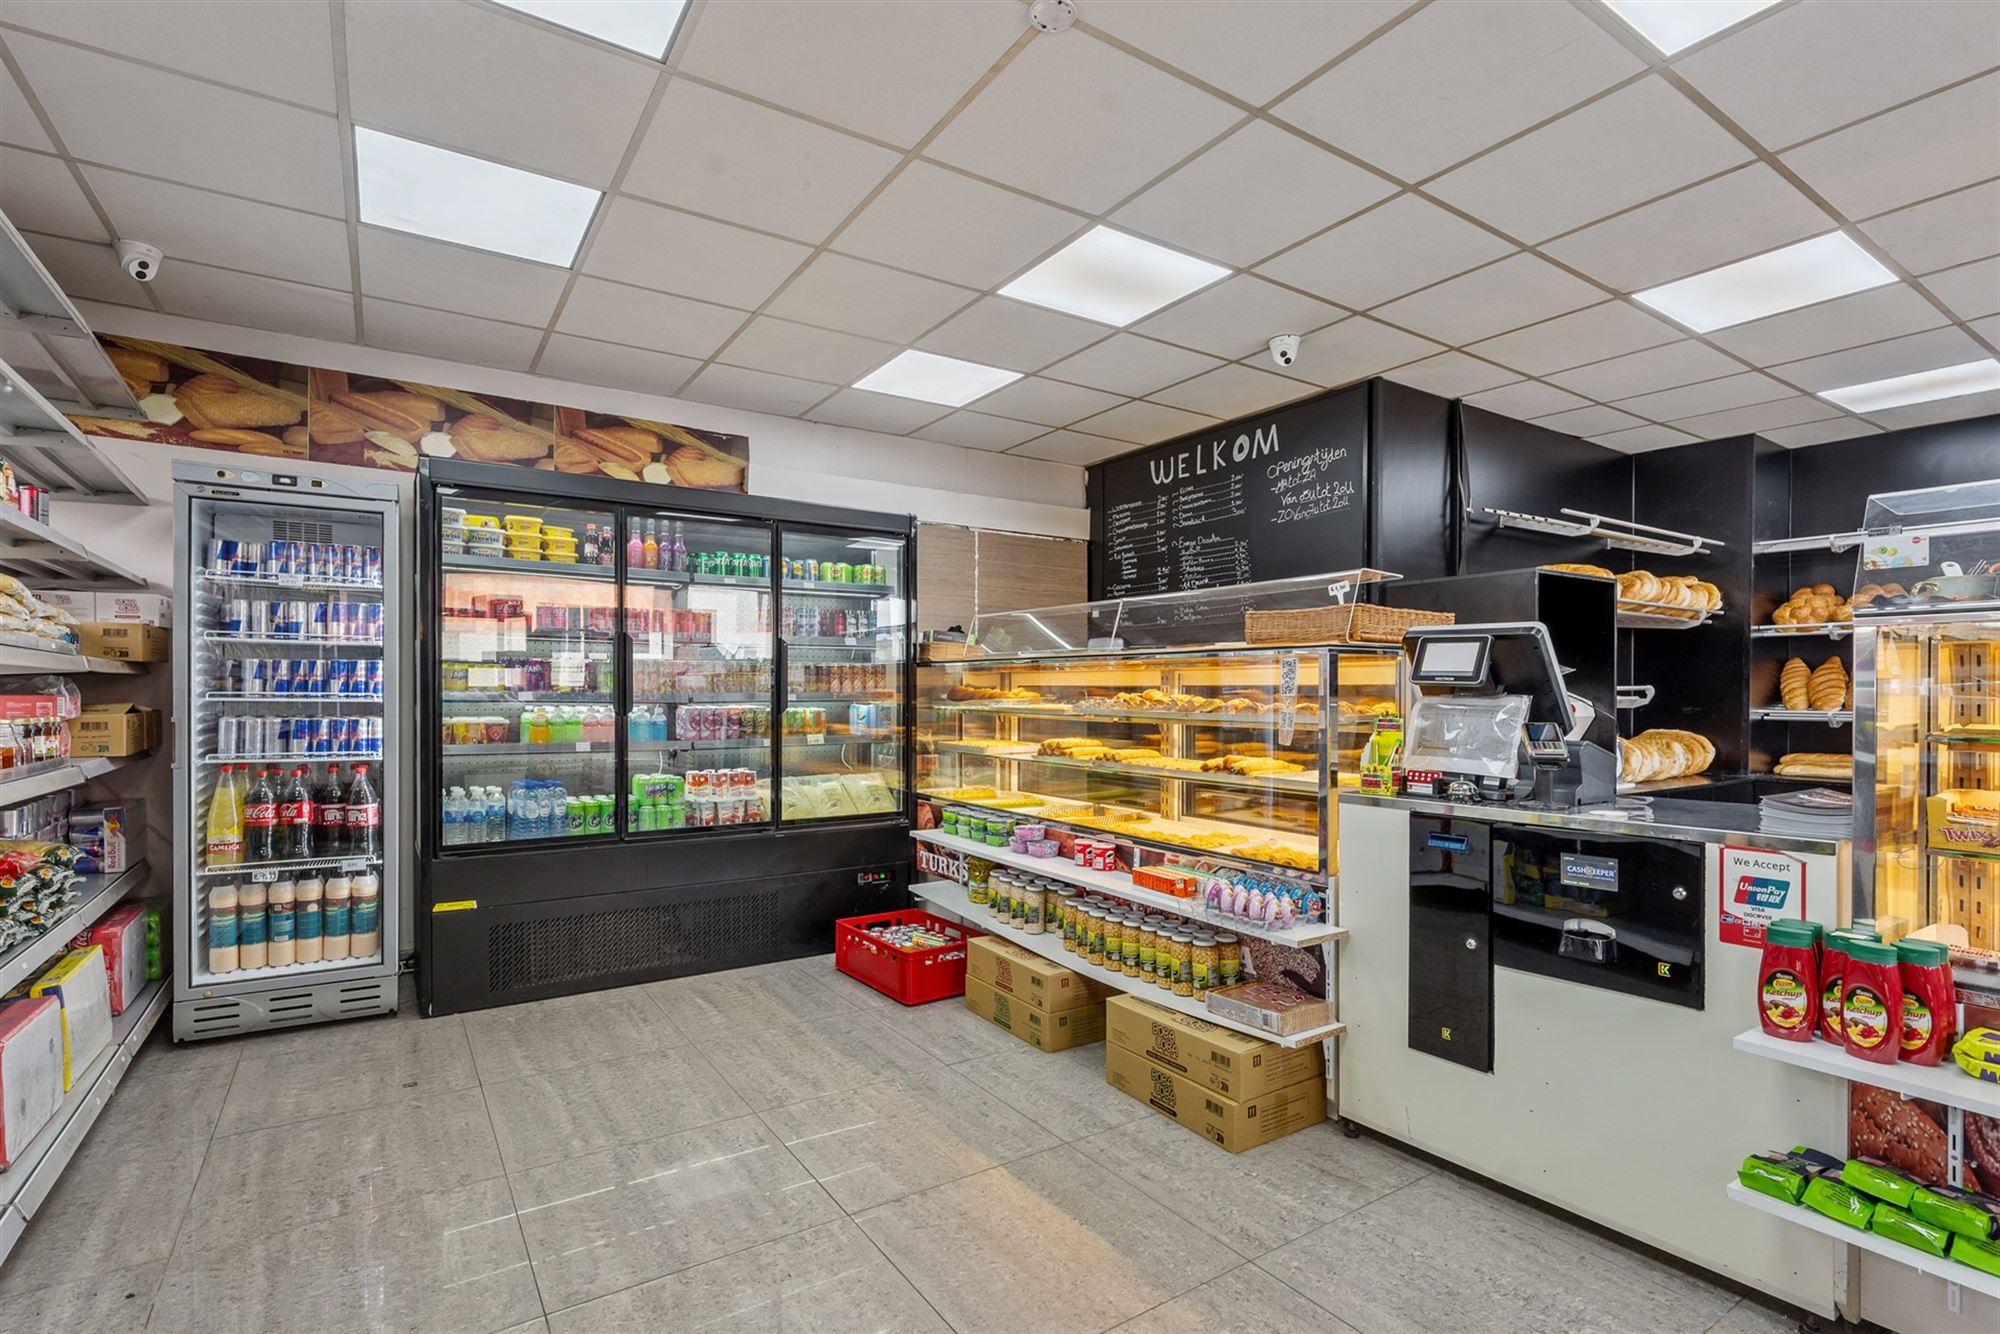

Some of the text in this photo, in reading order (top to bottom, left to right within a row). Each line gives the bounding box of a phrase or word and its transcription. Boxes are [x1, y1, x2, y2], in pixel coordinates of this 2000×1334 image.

[1150, 424, 1280, 485] WELKOM
[1733, 857, 1791, 872] We Accept
[1739, 882, 1786, 898] UnionPay
[1765, 988, 1803, 998] Ketchup
[1845, 1006, 1883, 1018] Ketchup
